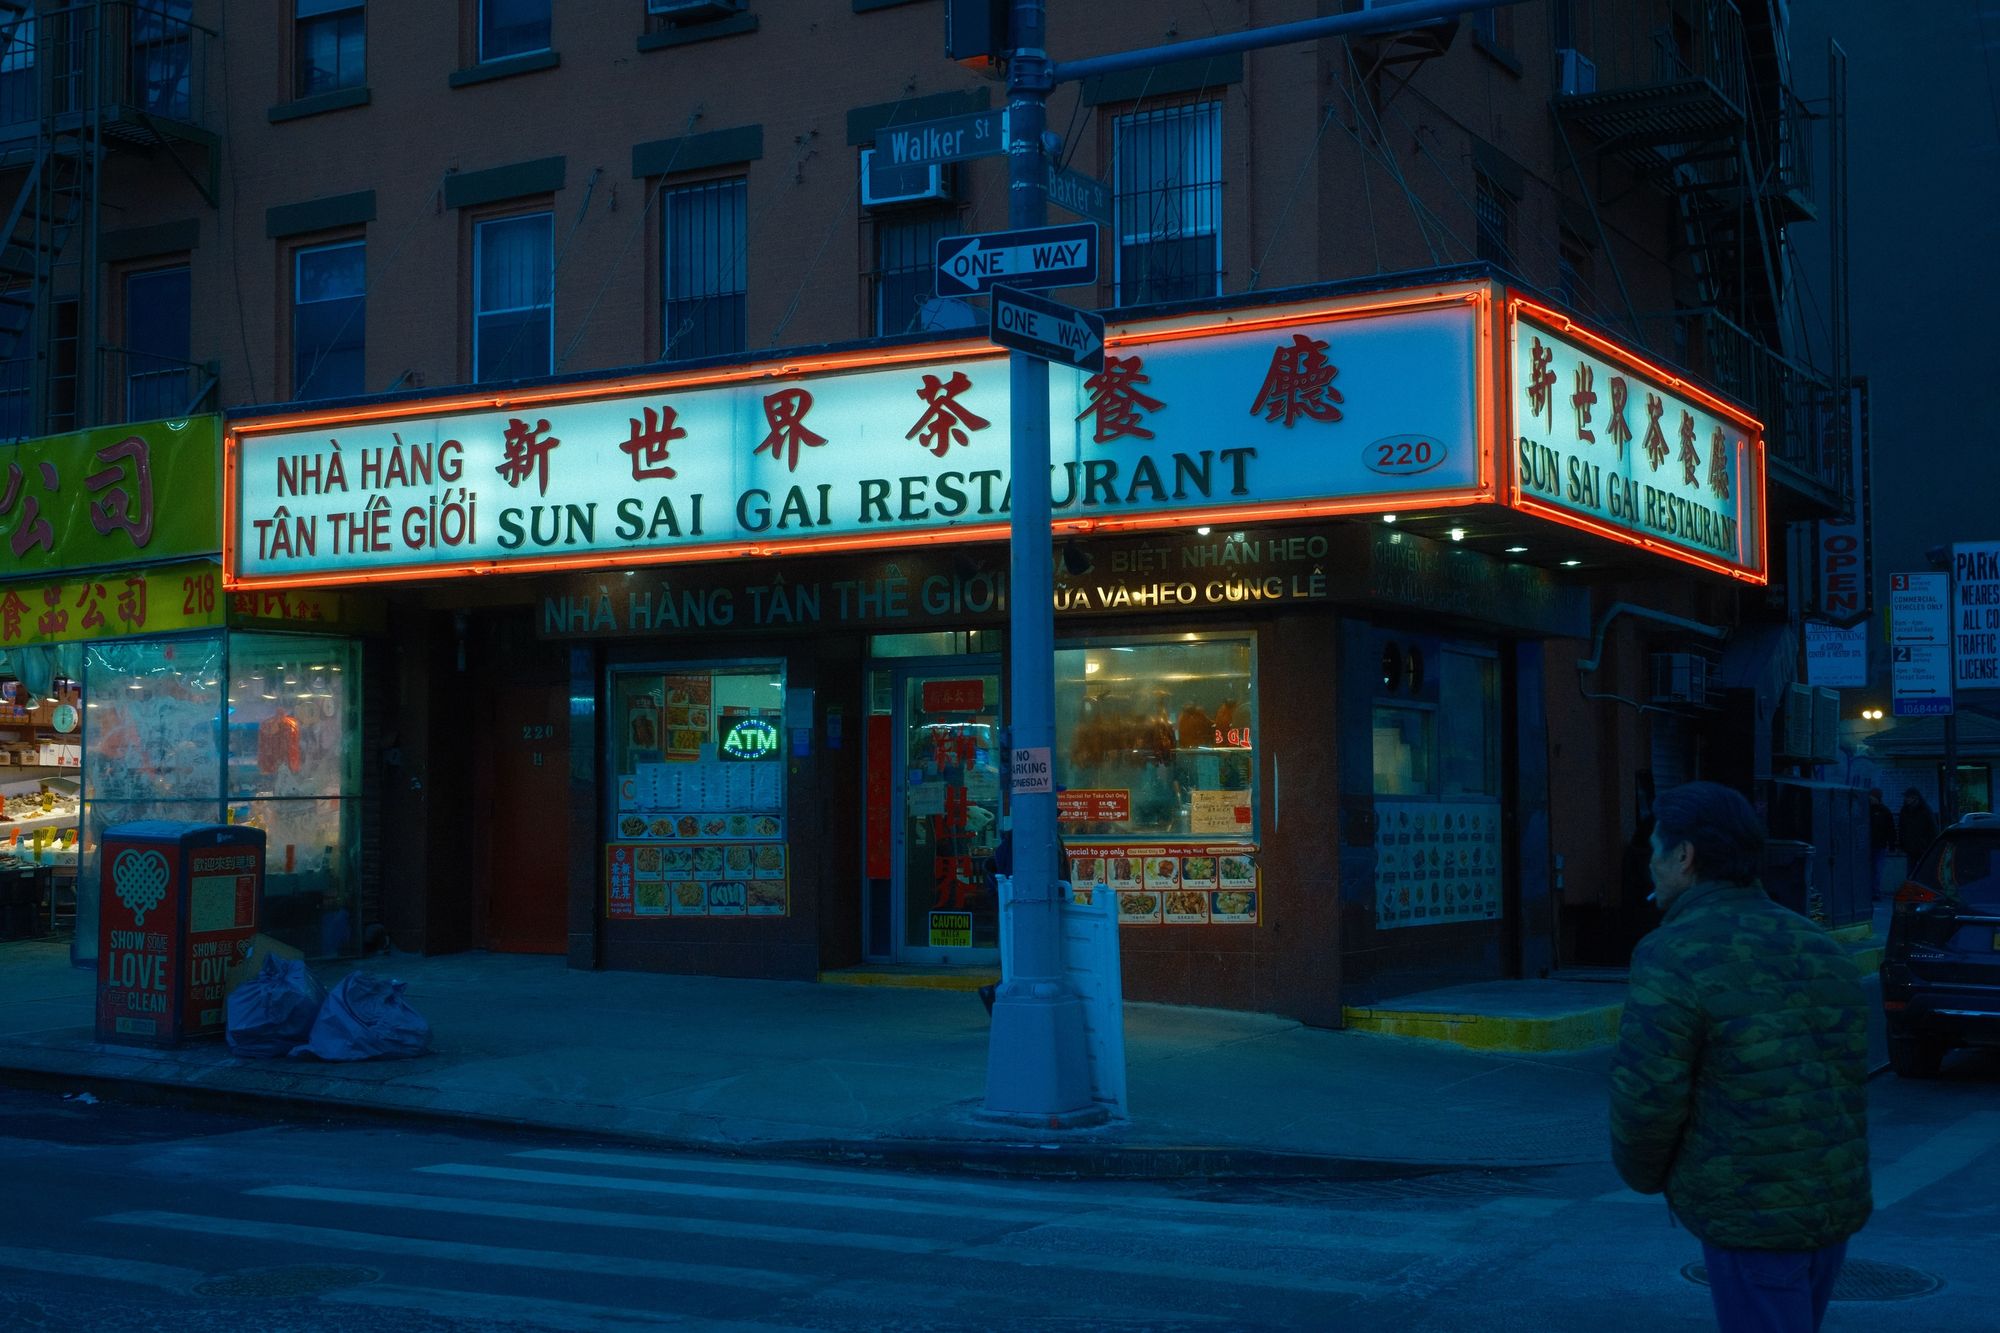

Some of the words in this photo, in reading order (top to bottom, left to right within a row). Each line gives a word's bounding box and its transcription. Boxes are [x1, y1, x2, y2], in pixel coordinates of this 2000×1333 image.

[891, 127, 964, 164] Walker
[975, 118, 990, 140] St
[1050, 164, 1090, 212] Baxter
[954, 252, 1004, 277] ONE
[1033, 243, 1082, 270] WAY
[1001, 306, 1038, 336] ONE
[1057, 322, 1092, 350] WAY
[495, 334, 1345, 496] 新世界茶餐廳
[1525, 335, 1730, 500] 新世界茶餐廳
[277, 439, 349, 497] NHÀ
[361, 432, 464, 489] HÀNG
[1378, 442, 1432, 467] 220
[0, 436, 154, 559] 公司
[497, 502, 598, 549] SUN
[615, 493, 705, 541] SAI
[736, 484, 832, 532] GAI
[857, 447, 1258, 523] RESTURANT
[1518, 436, 1560, 497] SUN
[1567, 455, 1601, 510] SAI
[1606, 471, 1640, 524] GAI
[1644, 484, 1738, 557] RESTAURANT
[254, 506, 317, 560] TÂN
[327, 494, 392, 555] THẾ
[1269, 535, 1328, 562] HEO
[1824, 535, 1858, 611] OPEN
[1957, 552, 2000, 581] PARK
[183, 573, 215, 616] 218
[1141, 582, 1197, 606] HEO
[1896, 576, 1905, 590] 3
[0, 574, 148, 641] 食品公司
[543, 585, 618, 633] NHÀ
[628, 582, 735, 629] HÀNG
[746, 572, 821, 625] TÂN
[1894, 595, 1936, 603] COMMERCIAL
[1894, 603, 1926, 611] VEHICLES
[1927, 602, 1943, 610] ONLY
[1963, 609, 1981, 630] ALL
[1897, 648, 1908, 661] 2
[1957, 634, 1996, 655] TRAFFIC
[1959, 658, 1999, 679] LICENSE
[1904, 704, 1938, 714] 106844
[523, 724, 554, 739] 220
[724, 729, 777, 750] ATM
[1011, 762, 1047, 774] ARKING
[1016, 751, 1030, 762] NO
[932, 915, 969, 928] CAUTION
[111, 930, 146, 950] SHOW
[146, 935, 168, 949] SOME
[192, 941, 217, 958] SHOW
[109, 952, 168, 991] LOVE
[127, 992, 168, 1013] CLEAN
[203, 986, 226, 1000] CLE
